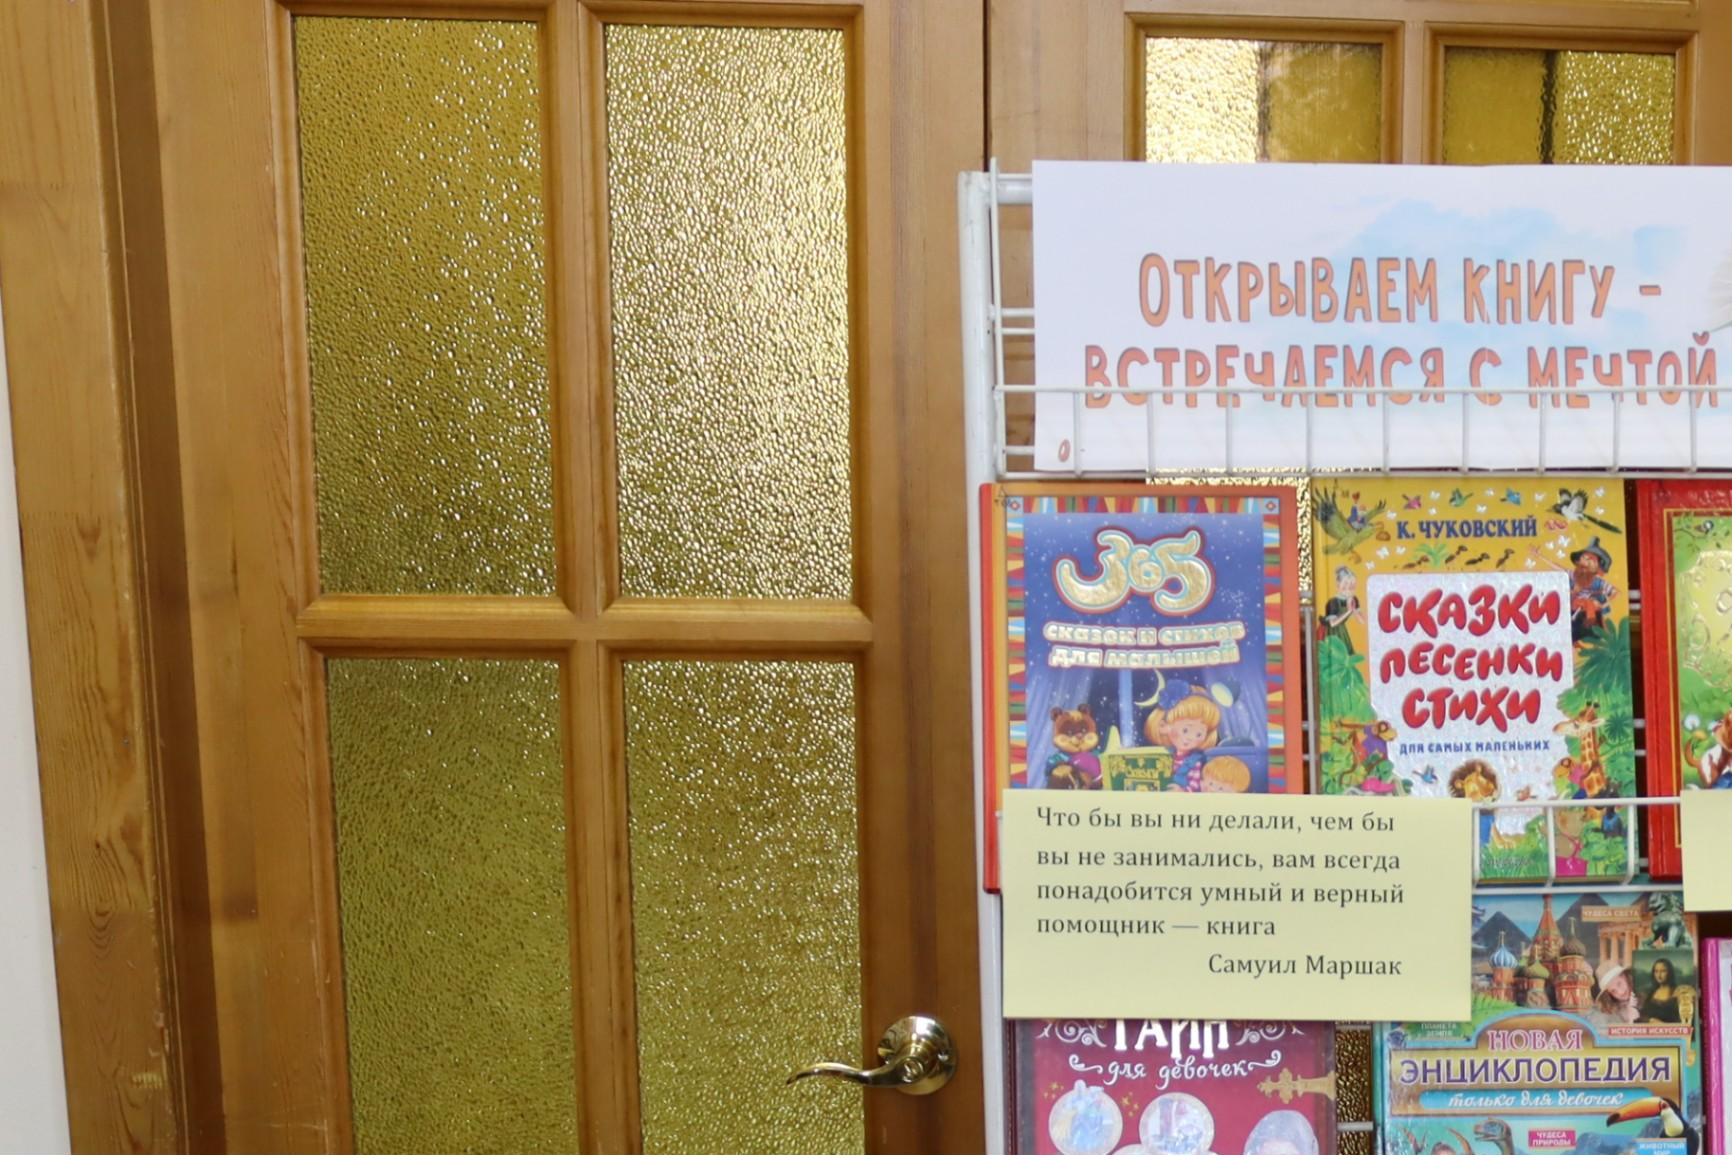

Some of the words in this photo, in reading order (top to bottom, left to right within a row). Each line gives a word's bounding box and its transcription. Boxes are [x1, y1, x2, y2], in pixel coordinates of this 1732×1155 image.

[1139, 253, 1438, 327] ОТКРЫВАЕМ
[1464, 258, 1614, 324] КНИГУ
[1085, 344, 1444, 408] ВСТРЕЧАЕМСЯ
[1470, 347, 1503, 407] С
[1528, 332, 1717, 408] МЕЧТОЙ
[1397, 521, 1415, 540] К.
[1418, 515, 1537, 538] ЧУКОВСКИЙ
[1055, 529, 1212, 612] 365
[1378, 584, 1560, 638] СКАЗКИ
[1380, 641, 1563, 683] ПЕСЕНКИ
[1402, 686, 1541, 733] СТИХИ
[1036, 807, 1080, 827] Что
[1089, 808, 1121, 828] бы
[1130, 812, 1162, 828] вы
[1171, 813, 1201, 829] ни
[1209, 813, 1301, 833] делали,
[1310, 815, 1353, 831] чем
[1361, 812, 1394, 832] бы
[1037, 849, 1069, 866] вы
[1078, 850, 1105, 866] не
[1113, 851, 1264, 871] занимались,
[1272, 853, 1314, 869] вам
[1324, 853, 1400, 872] всегда
[1036, 881, 1192, 902] понадобится
[1200, 882, 1281, 905] умный
[1291, 887, 1305, 902] и
[1313, 884, 1403, 908] верный
[1036, 918, 1165, 937] помощник
[1207, 919, 1276, 936] книга
[1208, 954, 1296, 978] Самуил
[1305, 954, 1402, 979] Маршак
[1487, 1029, 1582, 1051] НОВАЯ
[1103, 1060, 1146, 1084] для
[1156, 1056, 1250, 1089] девочек
[1399, 1057, 1670, 1085] ЭНЦИКЛОПЕДИЯ
[1448, 1092, 1515, 1107] только
[1521, 1089, 1553, 1107] для
[1558, 1089, 1624, 1106] девочек
